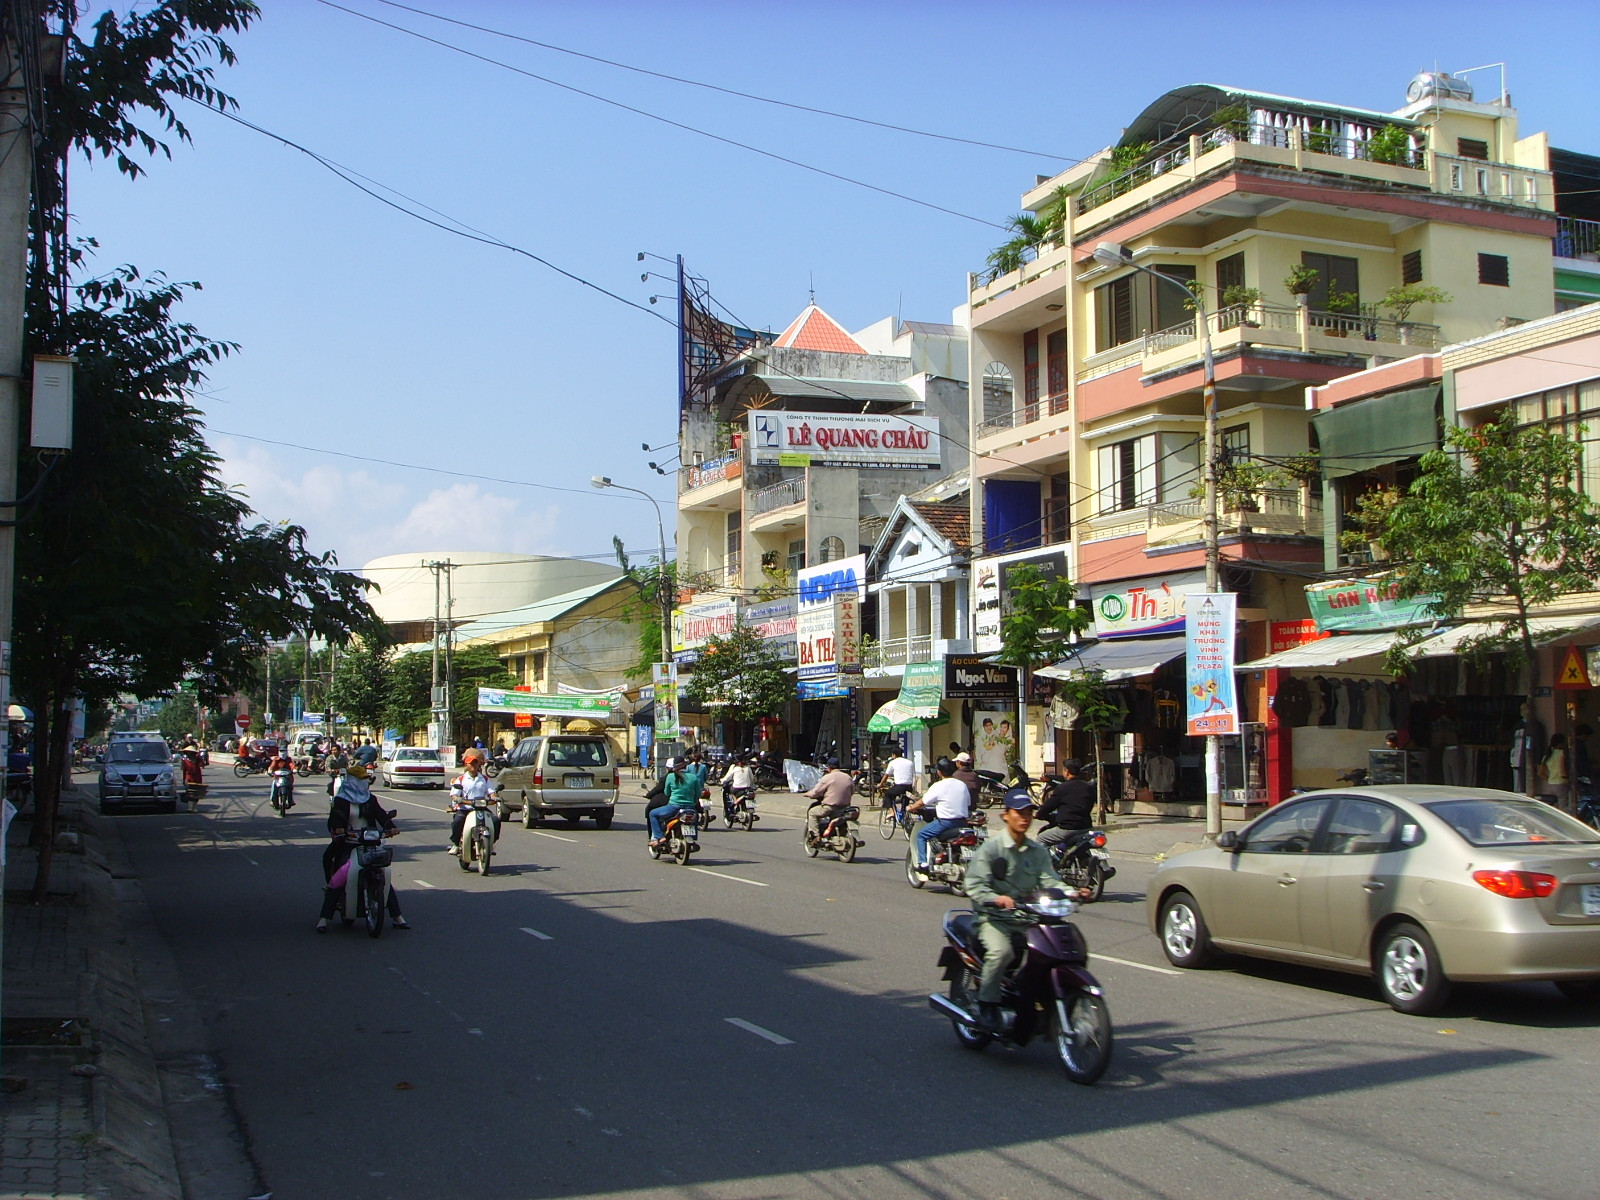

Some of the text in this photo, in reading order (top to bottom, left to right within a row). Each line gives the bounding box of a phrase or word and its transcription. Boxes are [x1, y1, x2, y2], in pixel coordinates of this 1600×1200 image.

[786, 422, 930, 451] LÊ QUANG CHÂU
[799, 568, 859, 604] NOKIA
[1326, 589, 1361, 609] LAN
[693, 616, 715, 643] QUANG
[1278, 625, 1295, 635] TOÀN
[955, 668, 985, 687] Ngọc
[1217, 719, 1228, 727] 11
